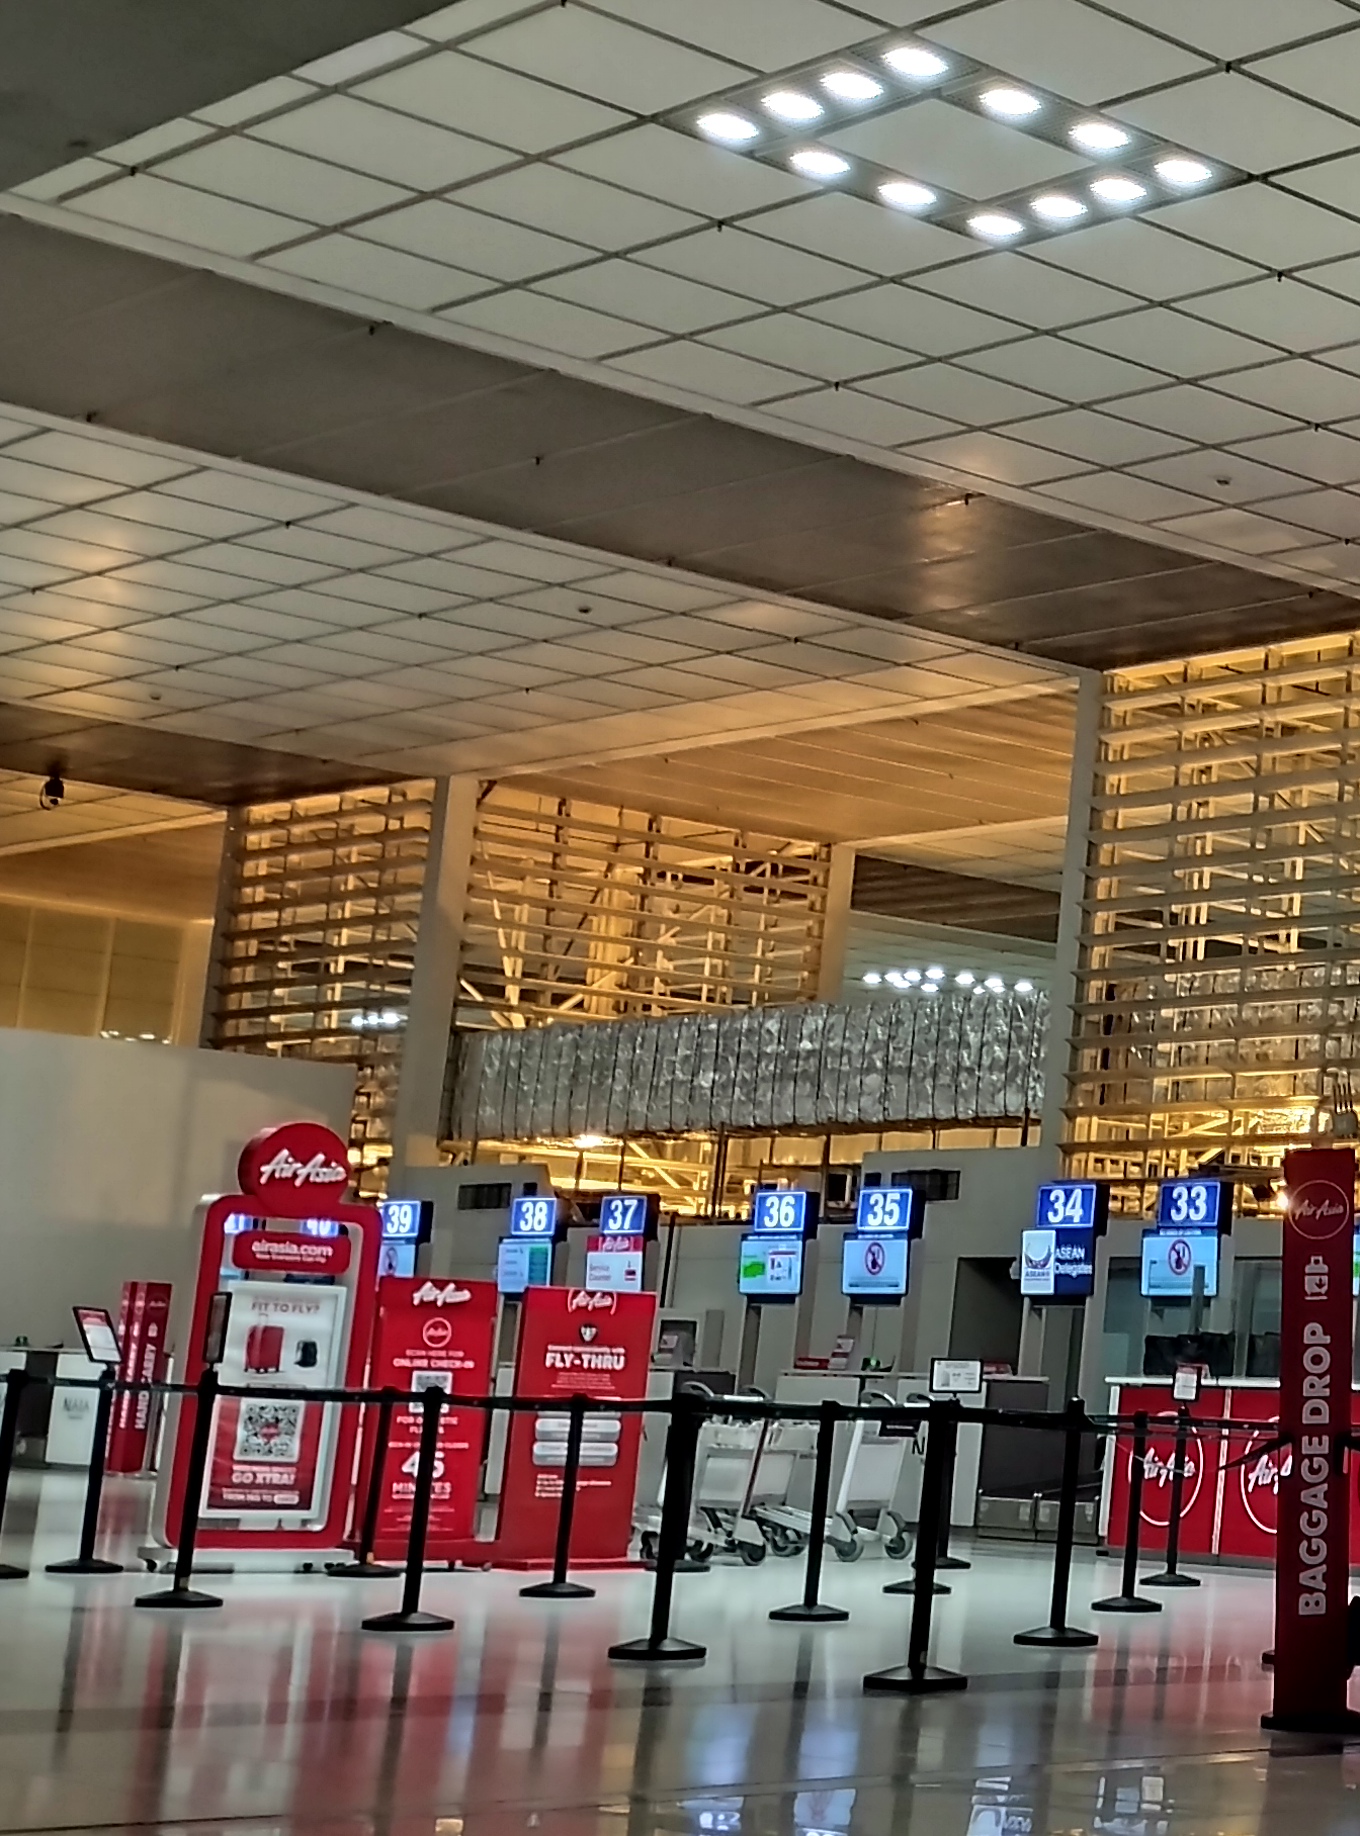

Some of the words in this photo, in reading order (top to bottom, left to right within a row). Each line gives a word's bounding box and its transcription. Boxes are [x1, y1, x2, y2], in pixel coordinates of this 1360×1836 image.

[260, 1148, 347, 1187] AirAsia
[386, 1204, 412, 1233] 39
[519, 1201, 547, 1231] 38
[608, 1199, 638, 1230] 37
[764, 1195, 795, 1227] 36
[867, 1193, 900, 1226] 35
[1047, 1188, 1083, 1223] 34
[1170, 1186, 1208, 1222] 33
[1294, 1199, 1345, 1220] AirAsia
[251, 1239, 334, 1257] airasia.com
[1055, 1246, 1086, 1260] ASEAN
[251, 1301, 269, 1312] FIT
[273, 1303, 290, 1313] TO
[545, 1352, 625, 1370] FLY-THRU
[1302, 1321, 1331, 1425] DROP
[1298, 1434, 1329, 1616] BAGGAGE
